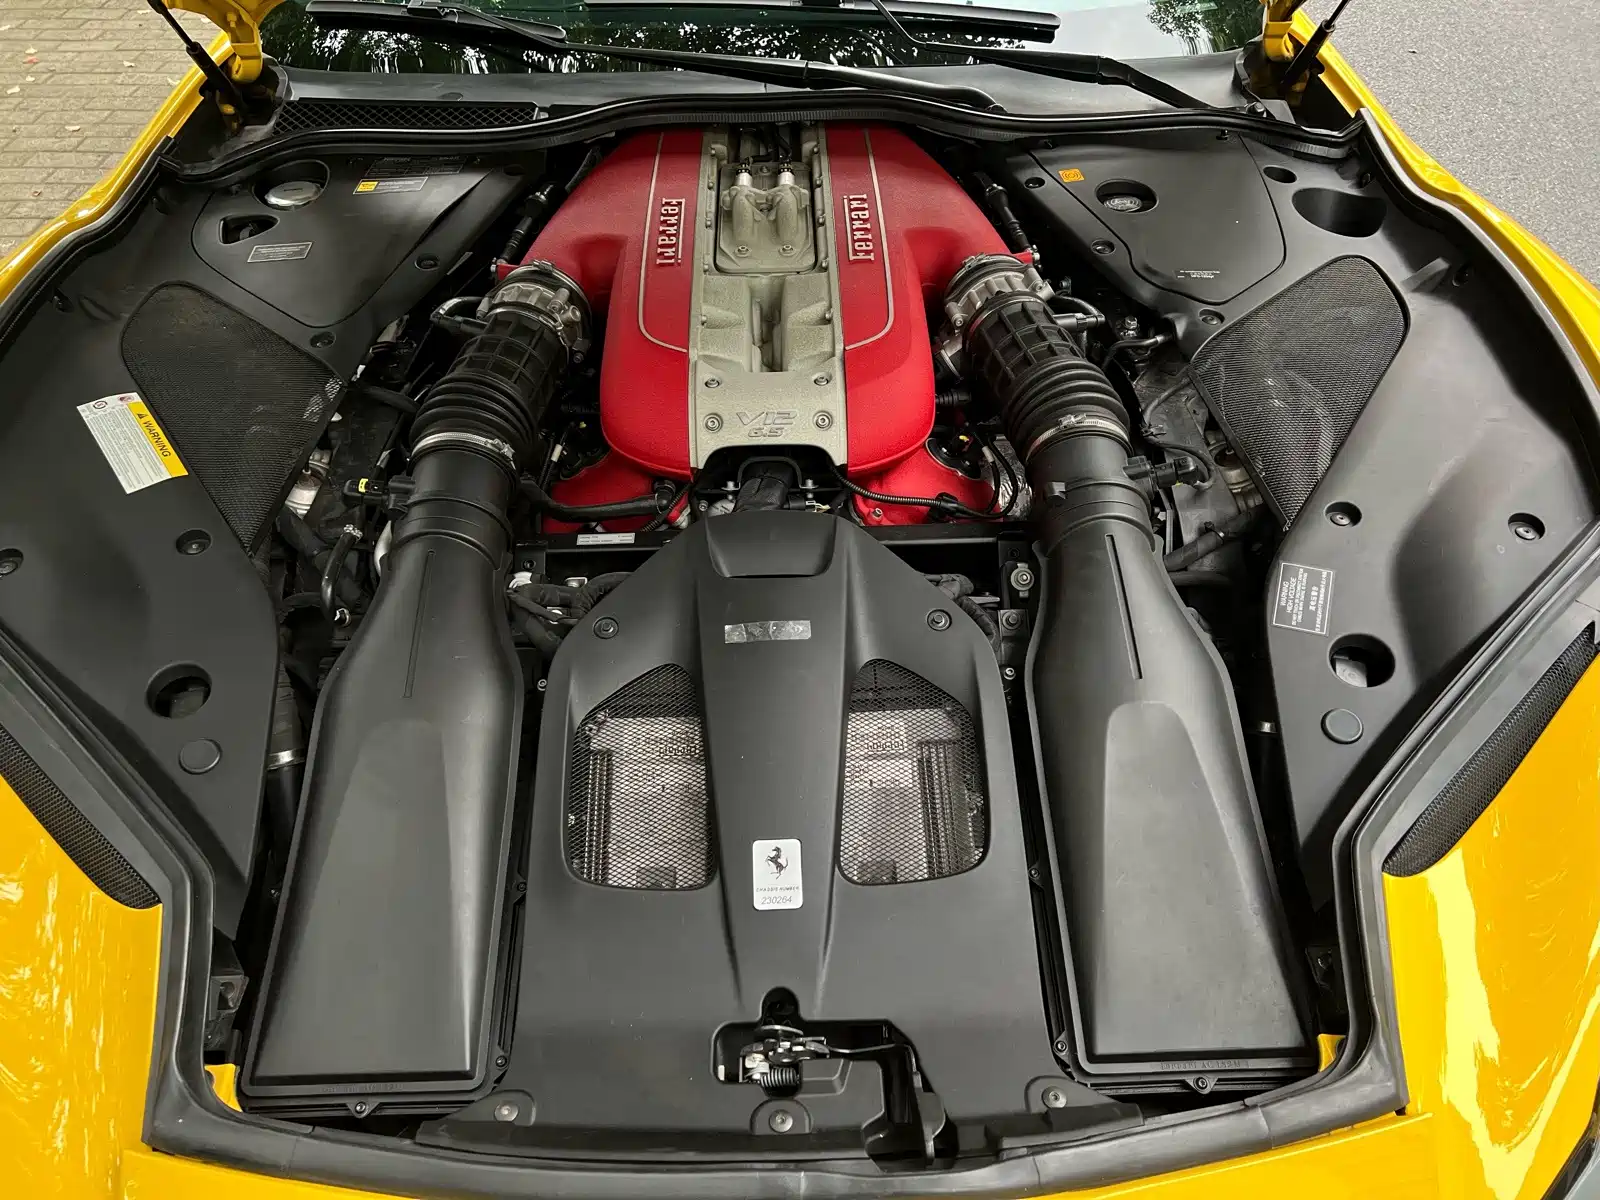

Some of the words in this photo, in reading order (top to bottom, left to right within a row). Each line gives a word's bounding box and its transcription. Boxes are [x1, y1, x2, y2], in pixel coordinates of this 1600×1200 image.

[656, 198, 686, 265] Ferrari
[843, 194, 875, 261] Ferrari
[736, 411, 798, 426] V12
[143, 420, 172, 458] WARNING
[747, 426, 785, 438] 6.5
[1280, 581, 1289, 606] WARNING
[761, 895, 793, 905] 230264
